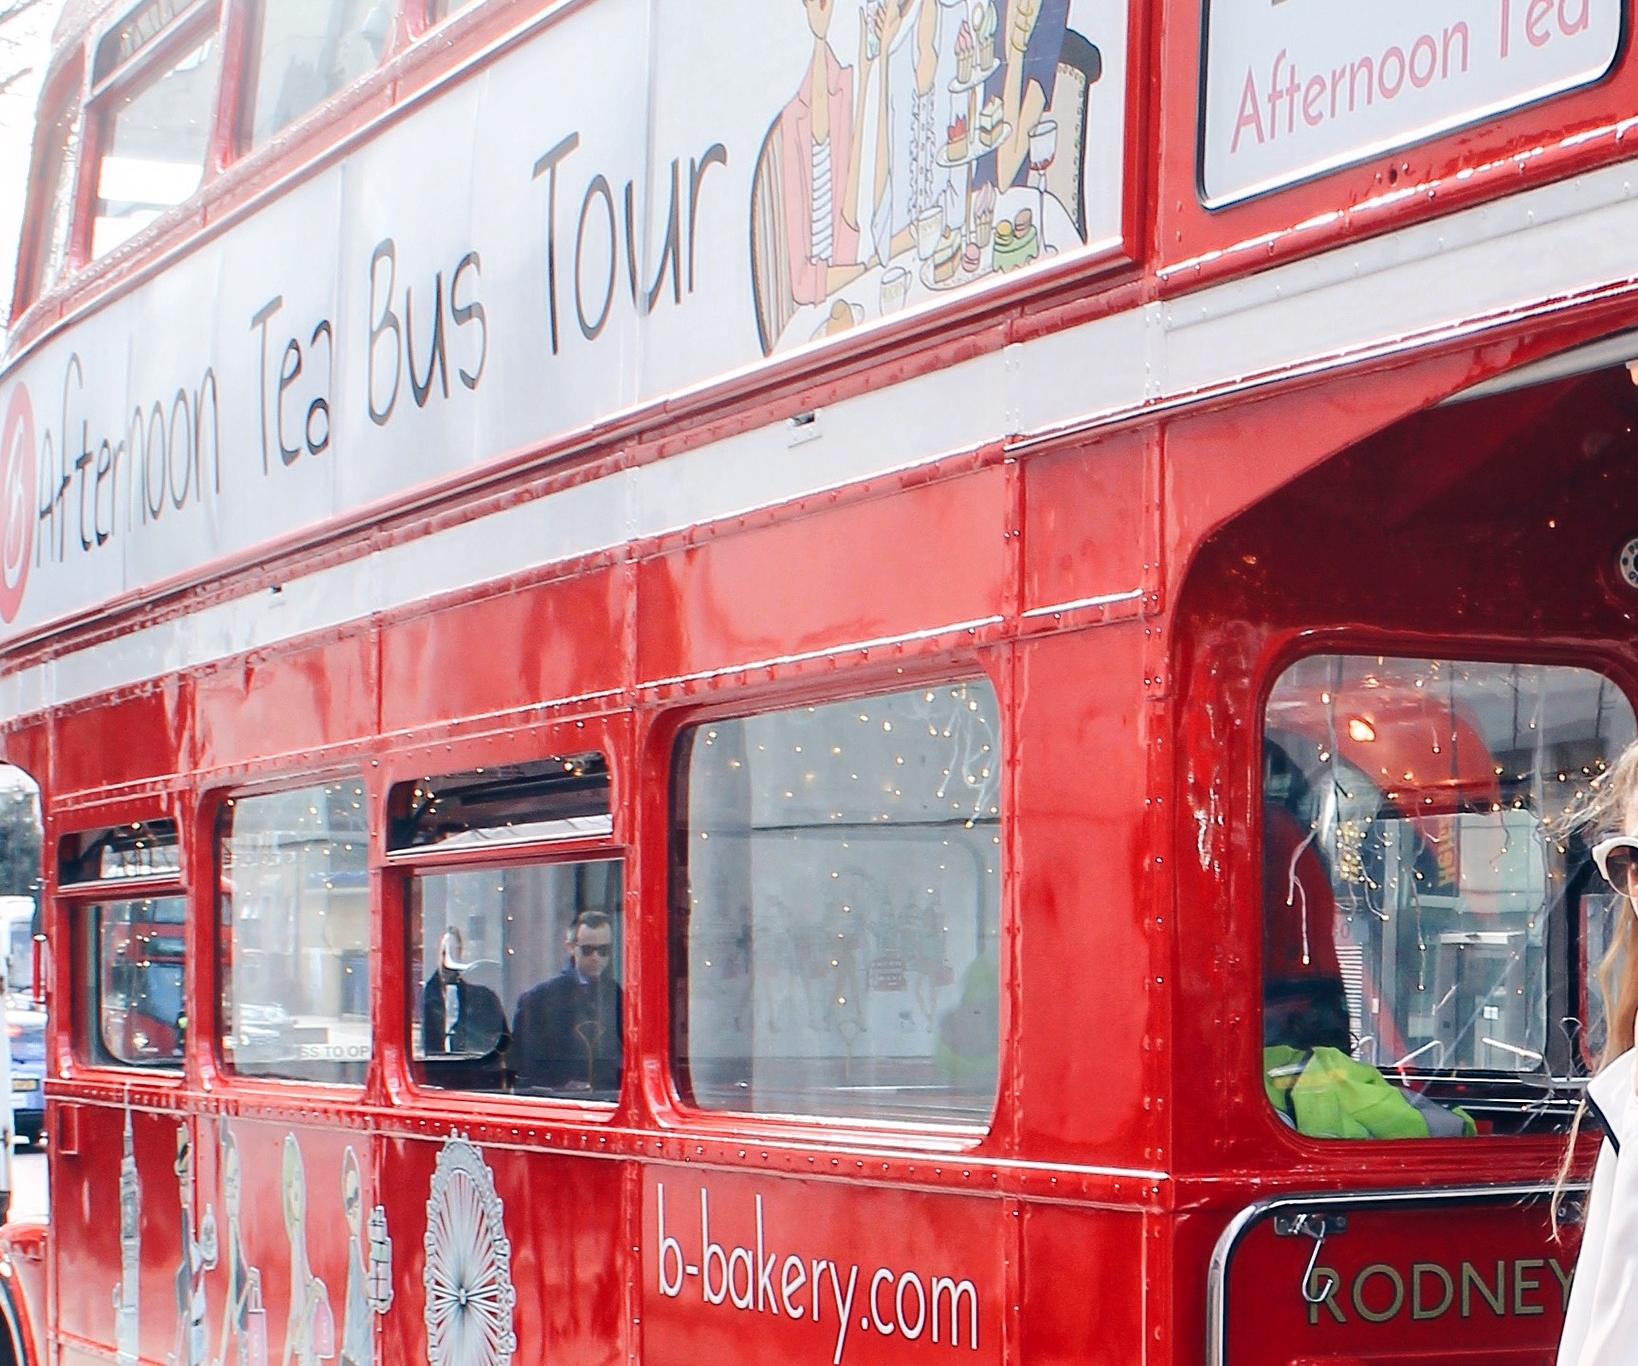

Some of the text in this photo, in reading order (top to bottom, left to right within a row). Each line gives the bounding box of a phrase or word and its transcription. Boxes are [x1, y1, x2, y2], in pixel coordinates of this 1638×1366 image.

[1229, 19, 1471, 154] Afternoon
[36, 130, 729, 569] Afternoon Tea Bus Tour
[656, 1182, 978, 1366] b-bakery.com
